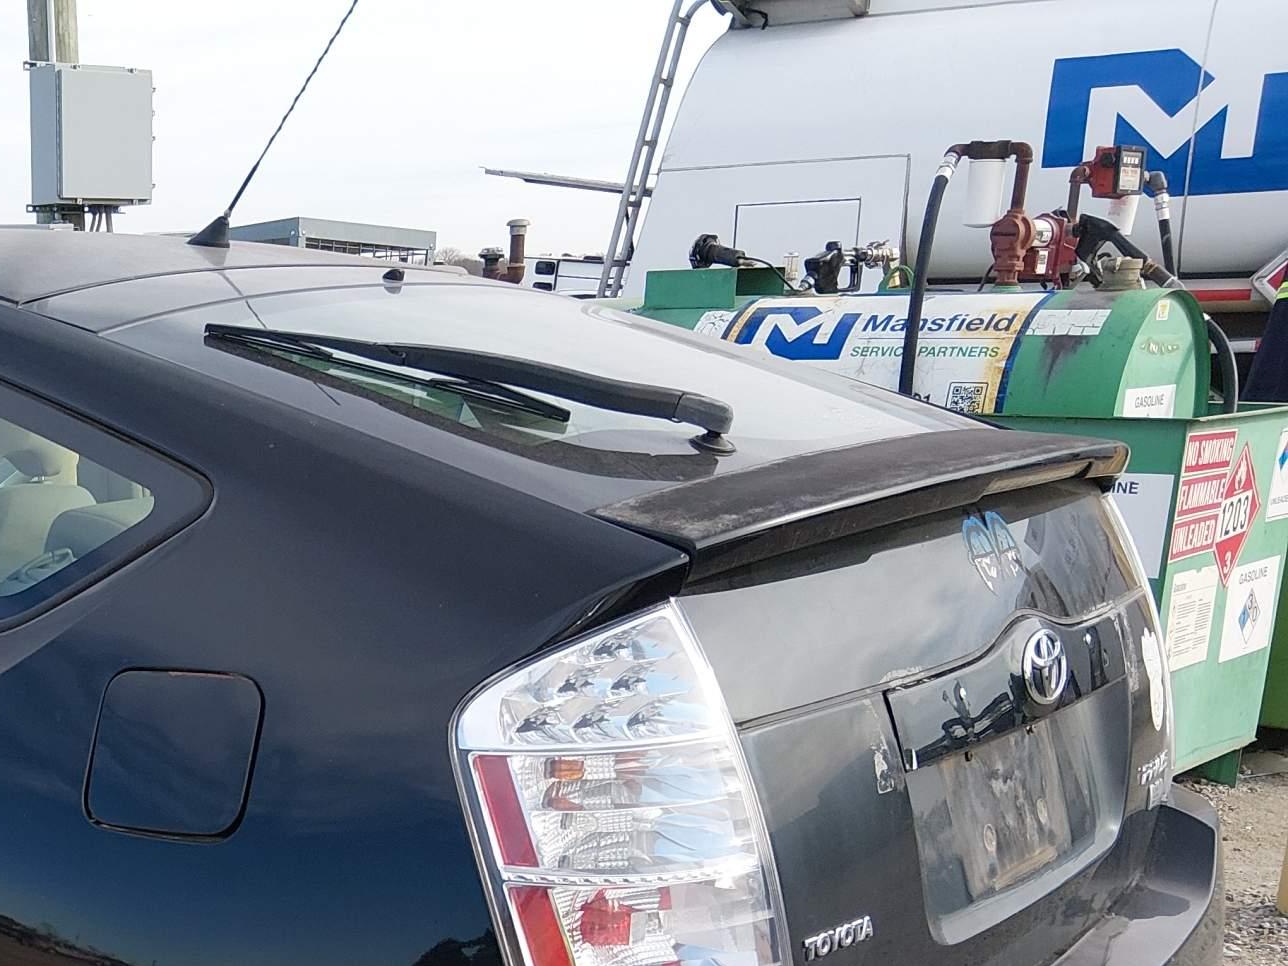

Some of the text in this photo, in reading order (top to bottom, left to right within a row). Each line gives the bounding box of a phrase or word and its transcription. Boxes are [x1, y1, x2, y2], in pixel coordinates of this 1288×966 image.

[850, 346, 1001, 358] SERVIC PARTNERS
[1134, 393, 1165, 409] GASOLINE
[1186, 437, 1235, 467] NO SMOKING
[1178, 478, 1226, 512] FLAMMABLE
[1220, 495, 1250, 538] 1203
[1172, 519, 1216, 555] UNLEADED
[1223, 551, 1232, 574] 3
[1238, 566, 1269, 585] GASOLINE
[803, 915, 873, 961] TOYOTA
